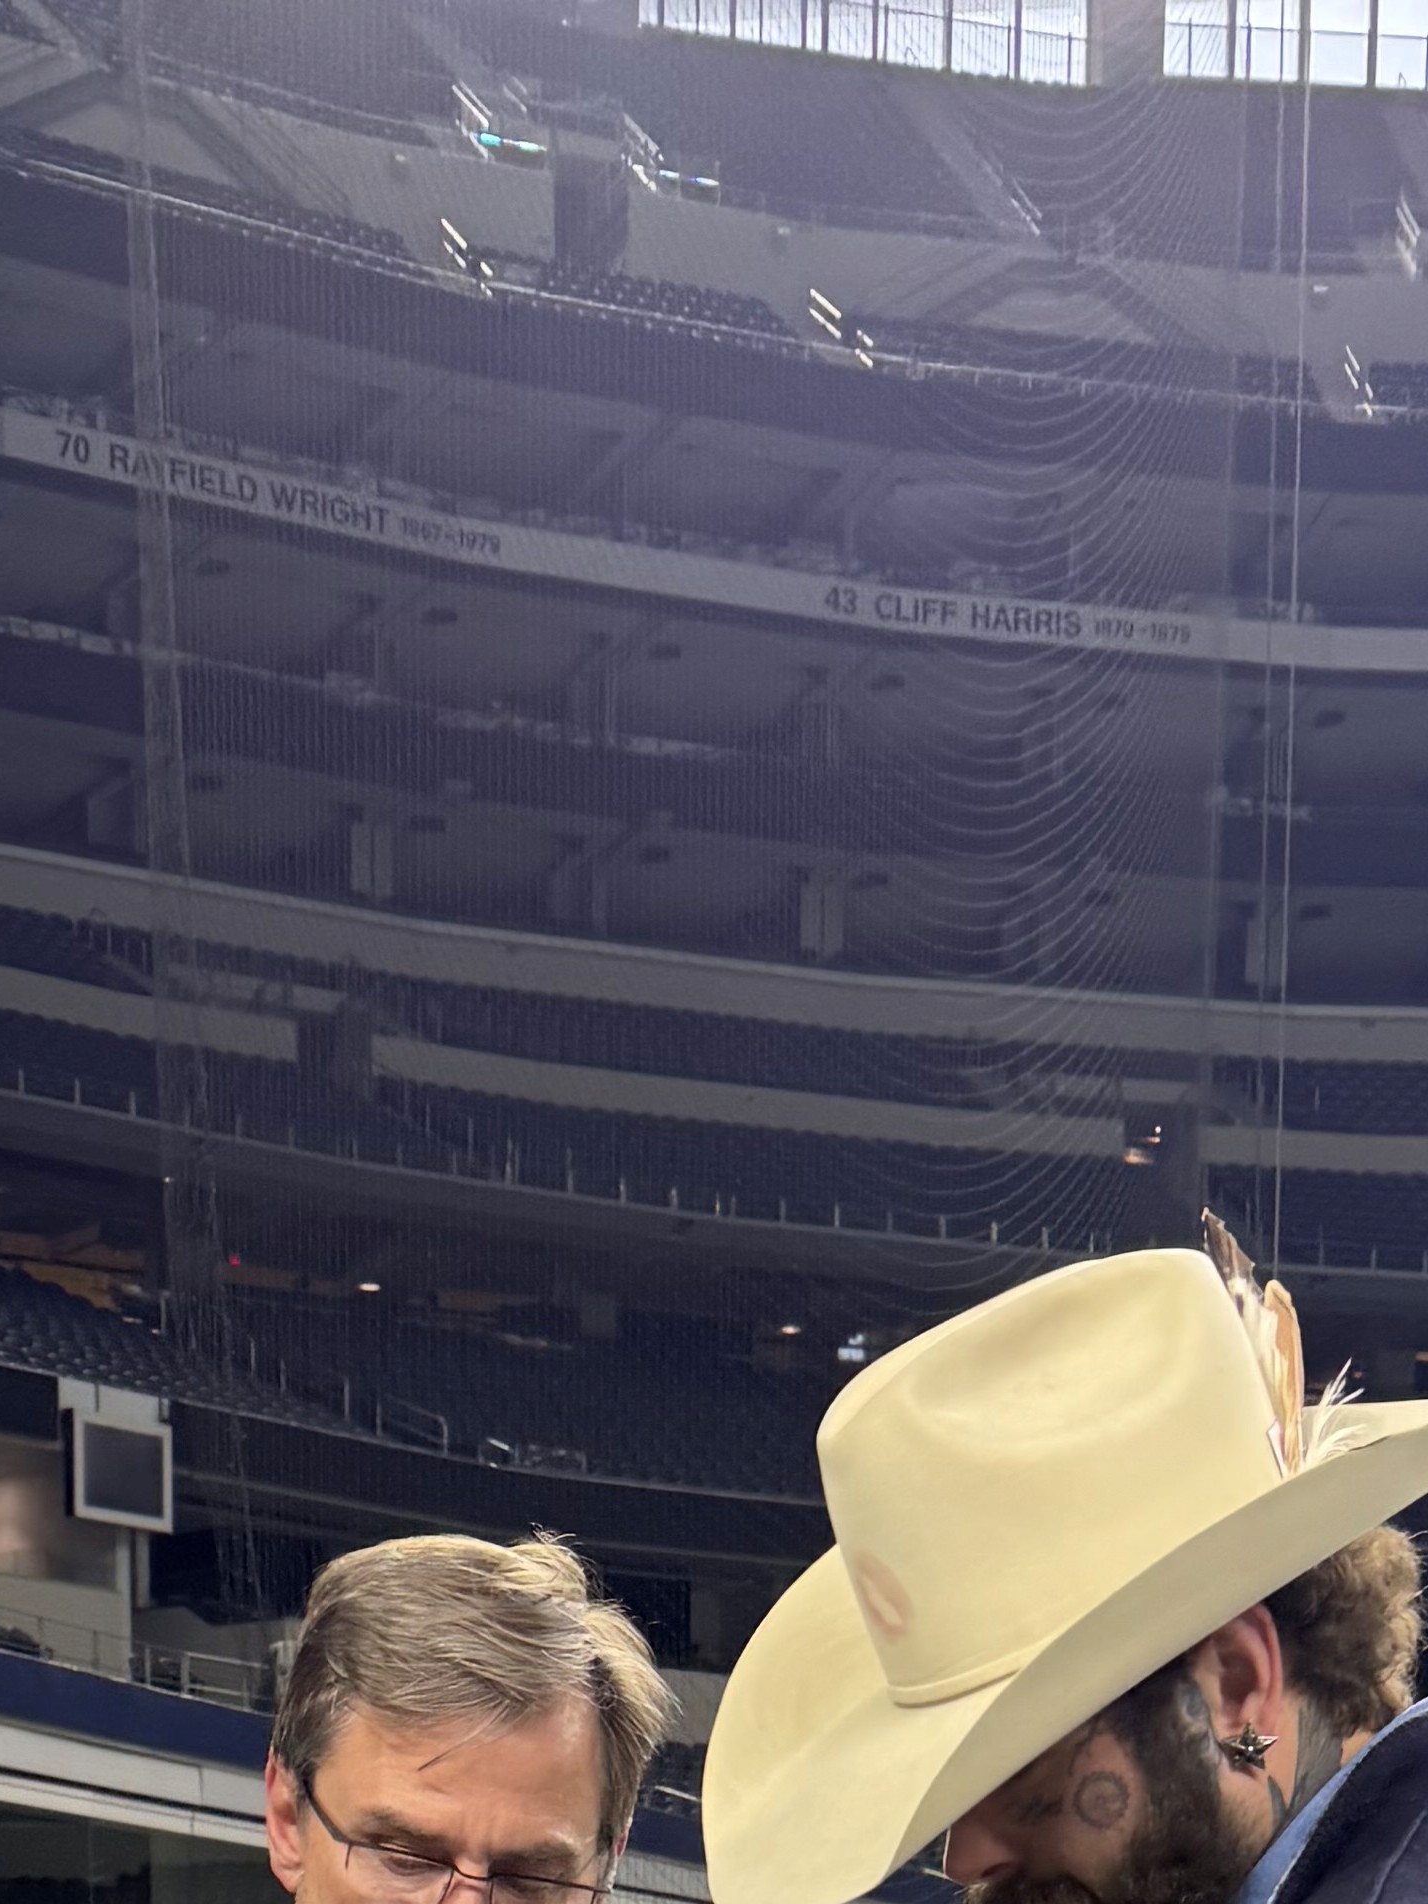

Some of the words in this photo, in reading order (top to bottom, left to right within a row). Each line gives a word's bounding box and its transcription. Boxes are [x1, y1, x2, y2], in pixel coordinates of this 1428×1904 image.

[56, 429, 90, 465] 70
[109, 442, 258, 504] RAYFIELD
[270, 480, 390, 535] WRIGHT
[824, 586, 858, 615] 43
[875, 592, 958, 625] CLIFF
[972, 603, 1082, 640] HARRIS
